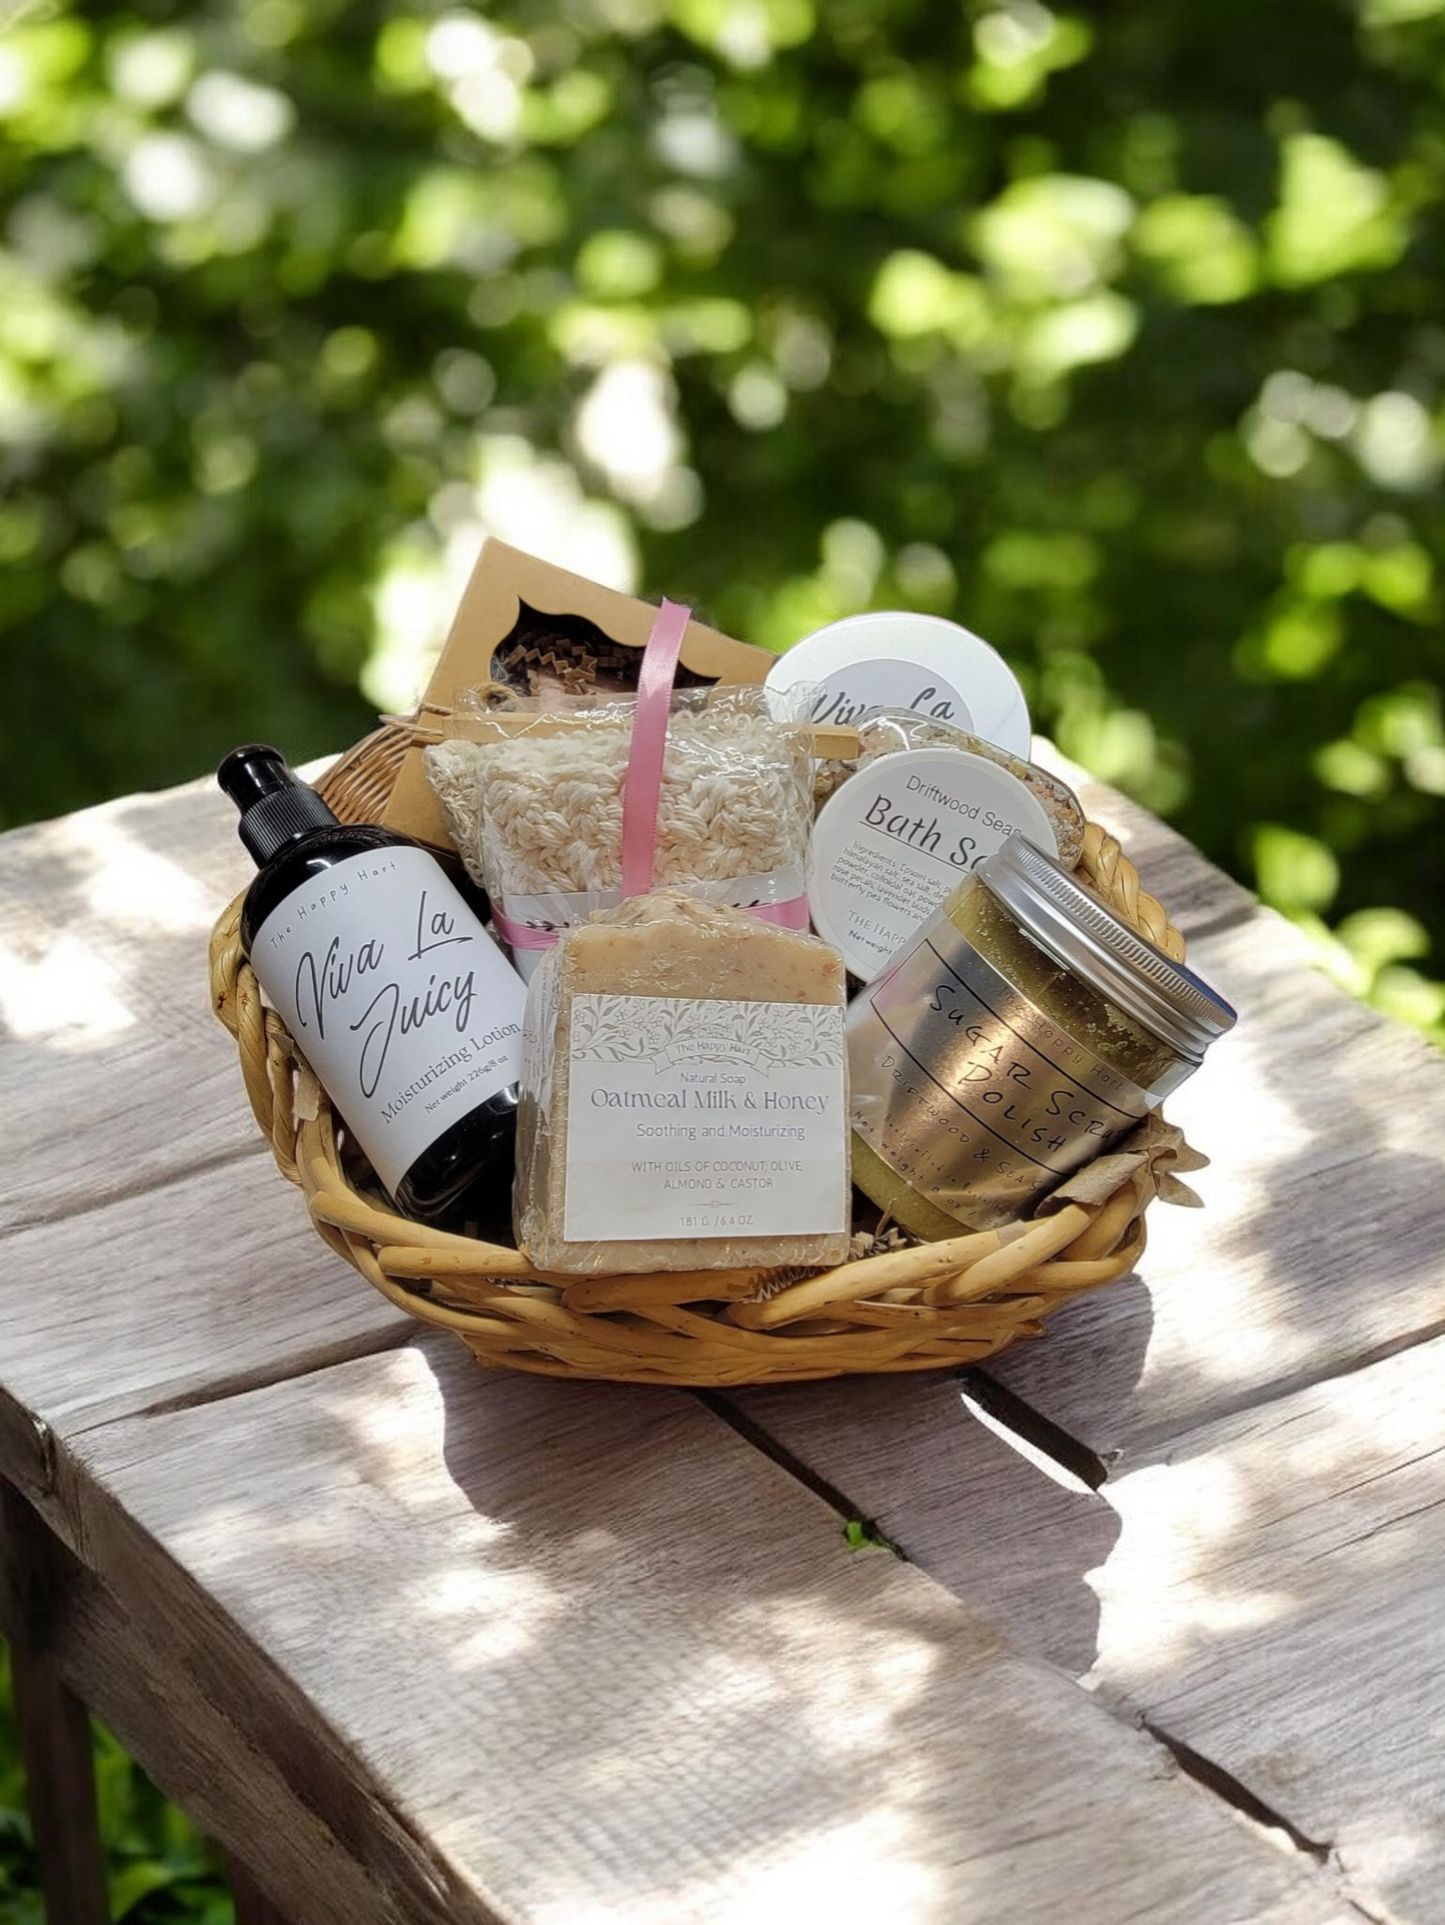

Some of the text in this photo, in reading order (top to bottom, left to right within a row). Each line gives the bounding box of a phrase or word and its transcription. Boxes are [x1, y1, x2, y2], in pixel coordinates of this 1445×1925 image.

[905, 775, 981, 820] Driftwood
[864, 793, 942, 853] Bath
[832, 864, 850, 877] rose
[876, 884, 911, 906] lavender
[843, 846, 884, 872] himalayan
[901, 875, 915, 887] sea
[870, 871, 903, 891] colloidal
[902, 885, 917, 898] oat
[899, 863, 927, 882] Epsom
[270, 860, 397, 949] The Happy Hart
[830, 872, 867, 896] butterfly
[865, 890, 882, 903] pea
[882, 896, 912, 918] flowers
[848, 910, 906, 945] THE HAPP
[848, 929, 865, 942] Net
[295, 890, 474, 1040] Viva La
[350, 970, 479, 1099] Juicy
[676, 1043, 695, 1054] The
[696, 1041, 726, 1053] Happy
[1032, 1016, 1084, 1065] Happy
[1090, 1063, 1124, 1091] Hart
[380, 1046, 473, 1125] Moisturizing
[470, 1022, 522, 1051] Lotion
[424, 1098, 441, 1114] Net
[440, 1079, 468, 1102] weight
[498, 1055, 509, 1064] oz
[680, 1072, 746, 1086] Natural Soap
[590, 1088, 829, 1115] Oatmeal Milk & Honey
[881, 1054, 1025, 1185] DRIFTWOOD & SEA
[957, 1061, 1067, 1153] POLISH
[636, 1123, 806, 1141] Soothing and Moisturizing
[631, 1161, 662, 1173] WITH
[665, 1161, 691, 1172] OILS
[694, 1161, 710, 1172] OF
[713, 1161, 767, 1173] COCONUT,
[854, 1110, 876, 1135] Net
[881, 1140, 925, 1182] weight
[947, 1198, 962, 1210] oz
[663, 1178, 774, 1190] ALMOND & CASTOR
[680, 1216, 697, 1227] 181
